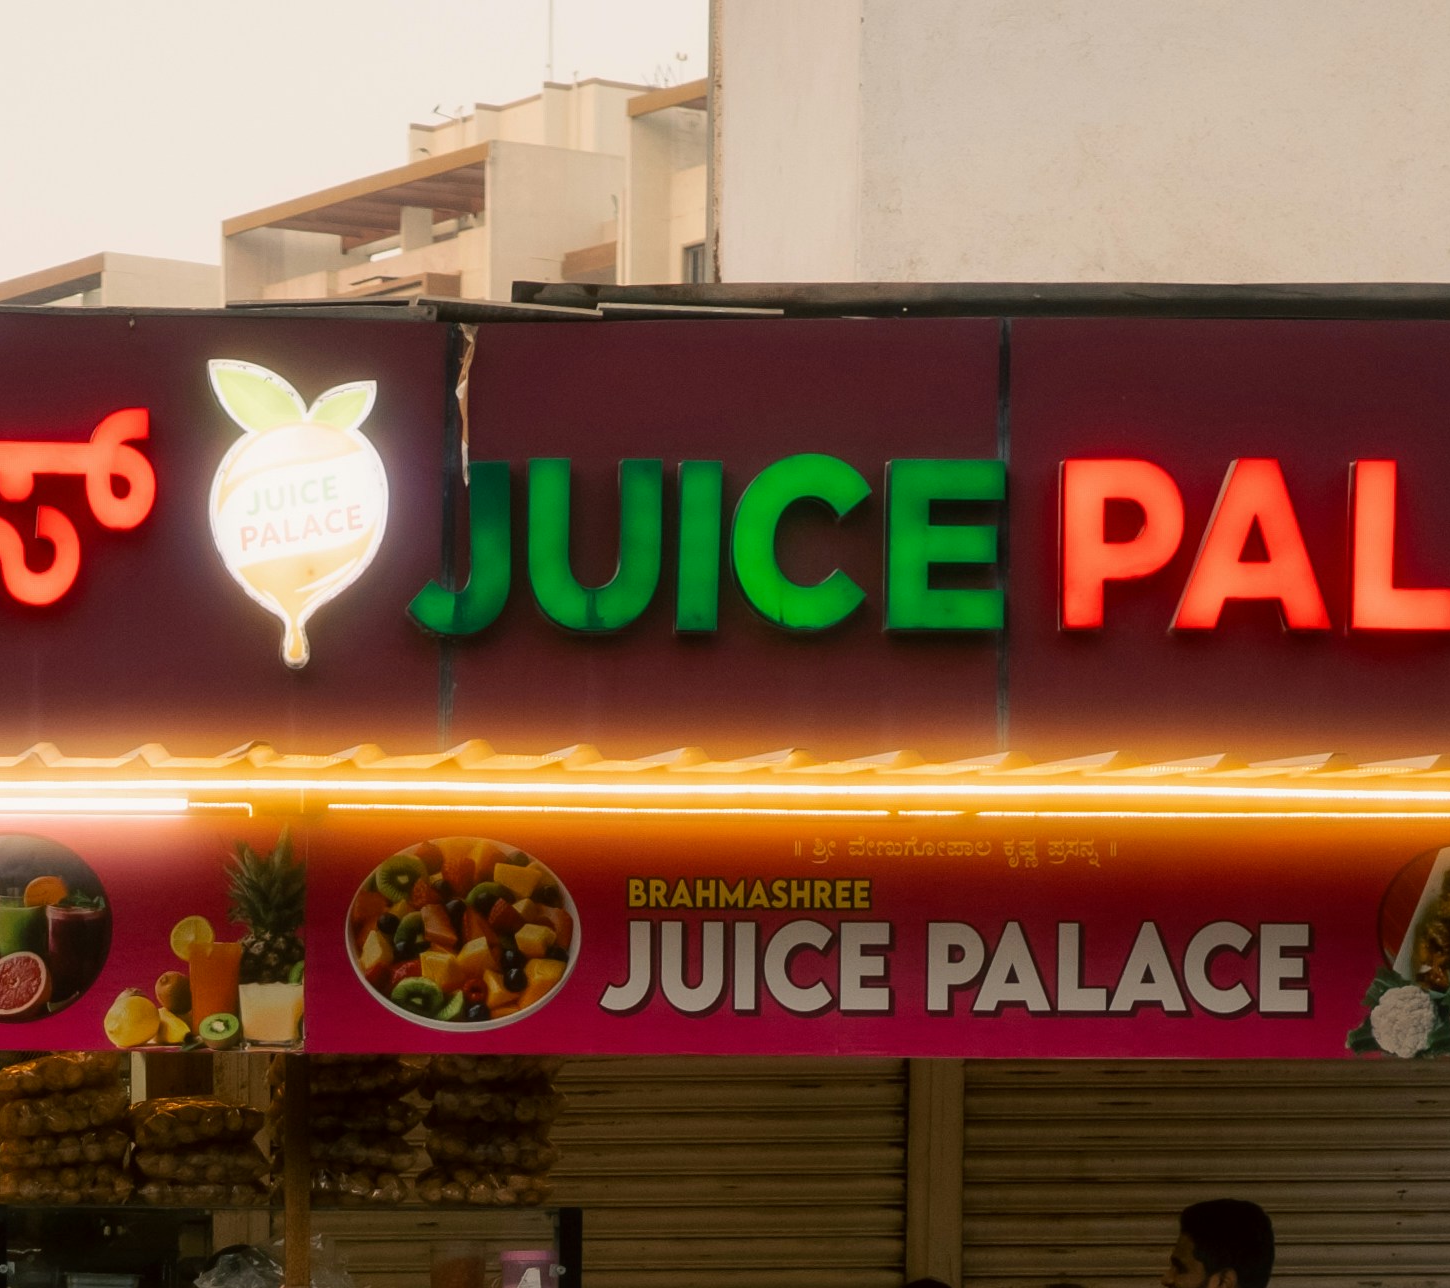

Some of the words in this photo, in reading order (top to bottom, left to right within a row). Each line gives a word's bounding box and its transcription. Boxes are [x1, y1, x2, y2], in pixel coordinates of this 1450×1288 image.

[247, 476, 339, 516] JUICE
[240, 504, 364, 552] PALACE
[404, 453, 1005, 634] JUICE
[627, 877, 873, 910] BRAHMASHREE
[599, 919, 892, 1013] JUICE
[927, 920, 1310, 1013] PALACE
